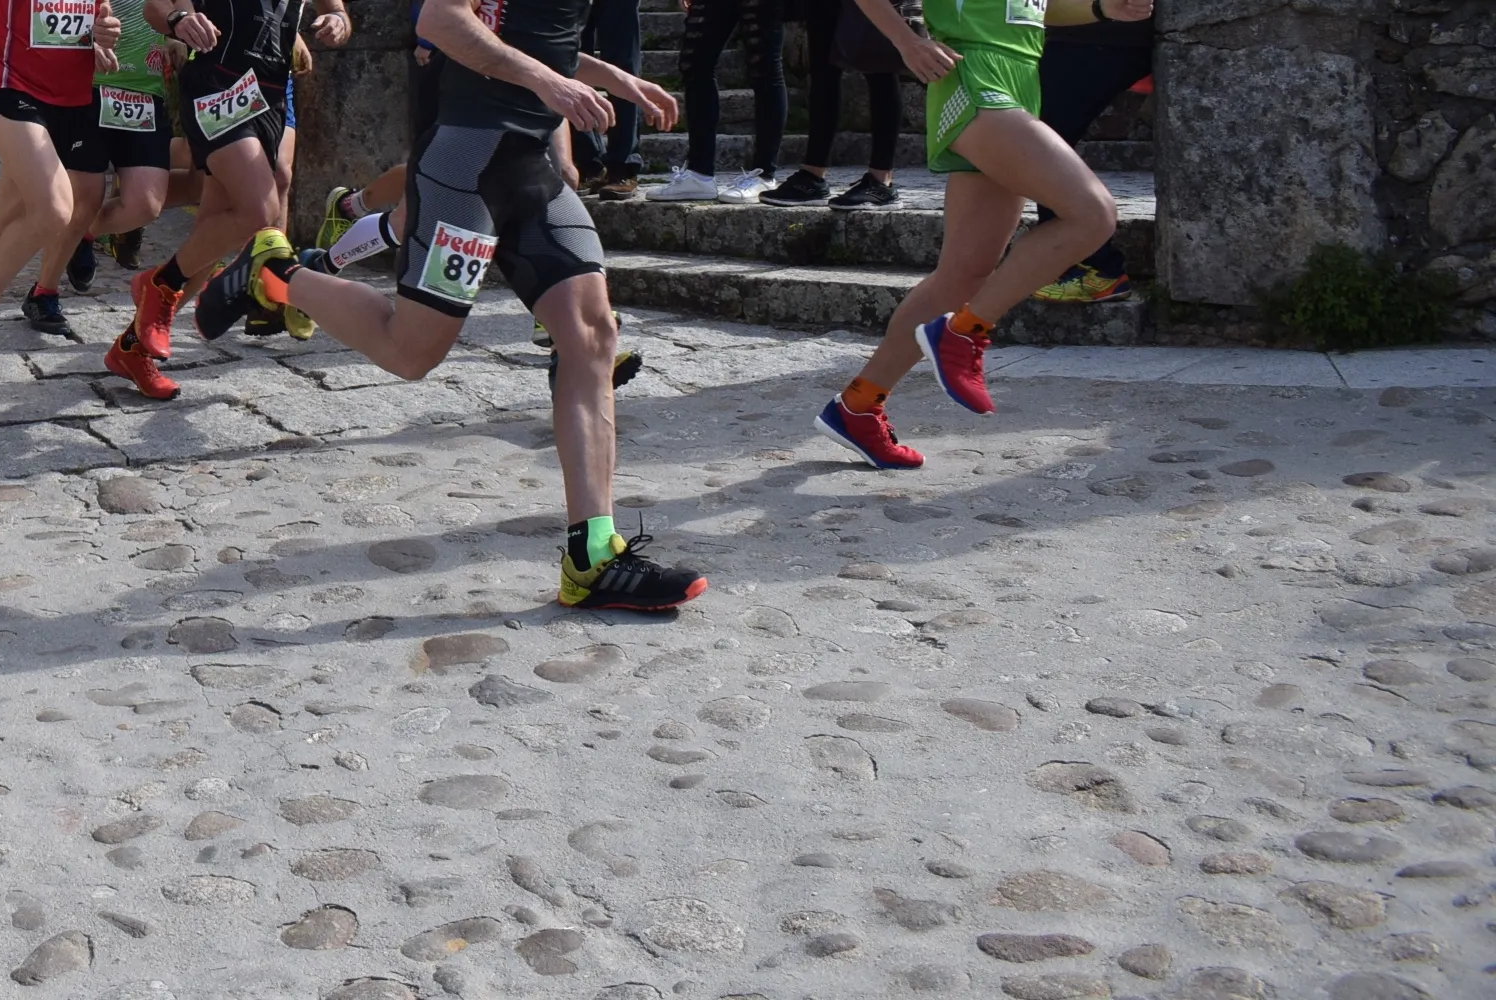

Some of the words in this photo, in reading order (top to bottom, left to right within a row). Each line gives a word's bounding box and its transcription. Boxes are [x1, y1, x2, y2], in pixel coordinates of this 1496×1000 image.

[32, 0, 94, 15] bedunia
[45, 15, 84, 36] 927
[196, 74, 256, 112] bedunia
[112, 100, 145, 120] 957
[209, 90, 249, 121] 976
